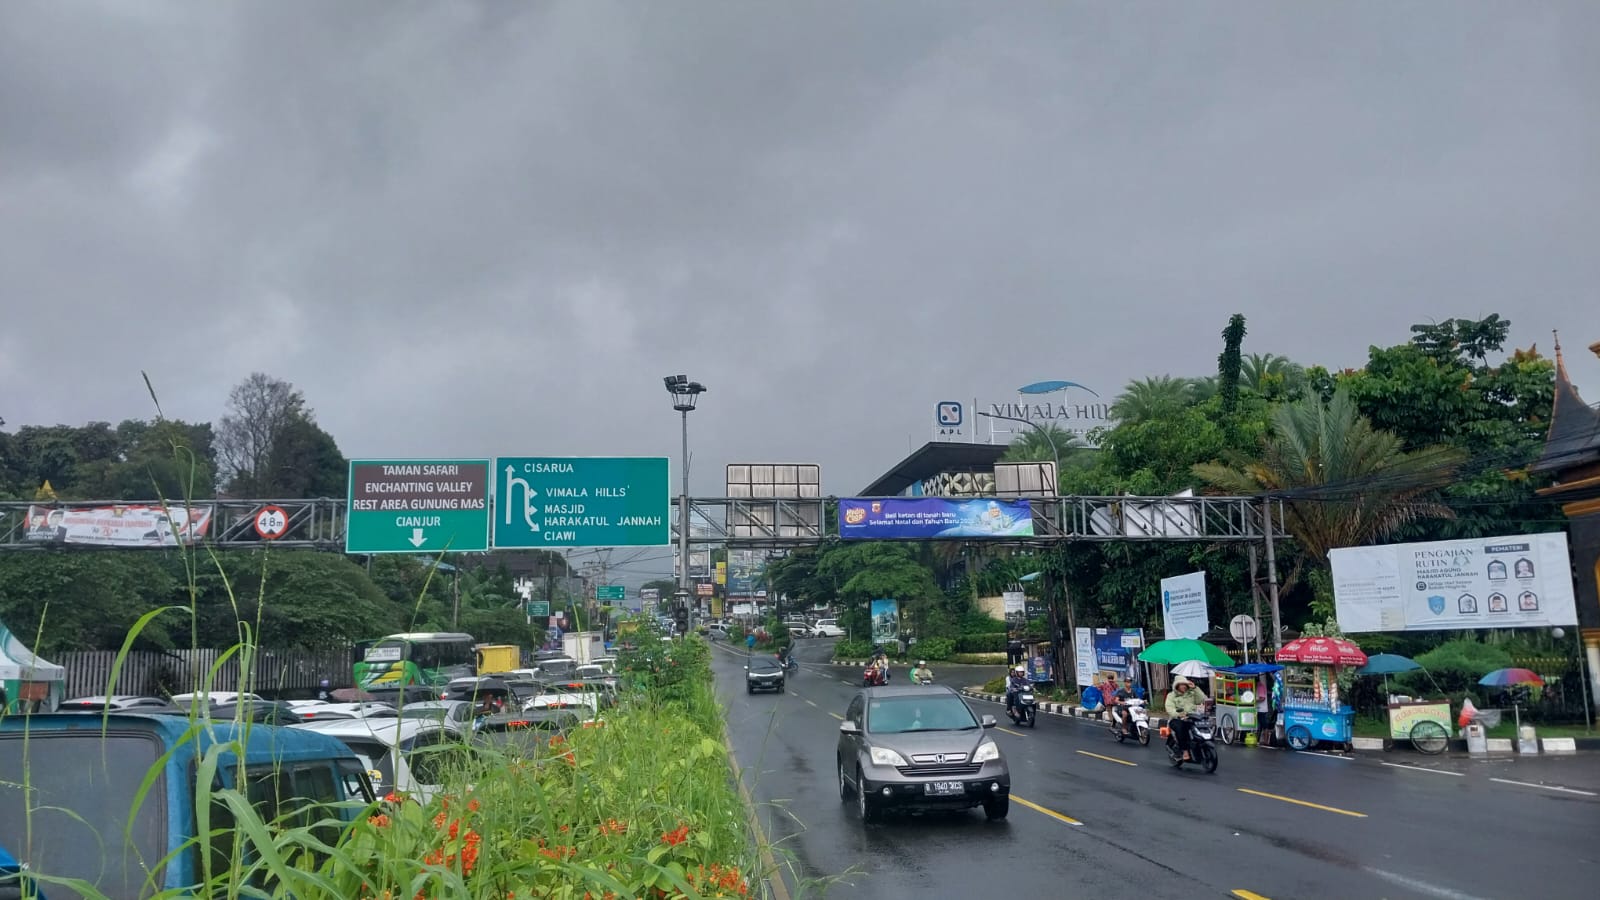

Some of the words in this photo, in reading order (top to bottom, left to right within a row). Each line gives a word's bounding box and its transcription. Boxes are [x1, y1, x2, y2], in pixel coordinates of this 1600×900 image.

[992, 402, 1070, 421] VIMALA
[383, 465, 420, 475] TAMAN
[424, 464, 459, 475] SAFARI
[524, 463, 574, 473] CISARUA
[365, 482, 433, 493] ENCHANTING
[436, 482, 473, 492] VALLEY
[546, 487, 588, 497] VIMALA
[595, 487, 626, 497] HILLS
[353, 499, 377, 510] REST
[380, 499, 408, 510] AREA
[411, 499, 458, 510] GUNUNG
[460, 498, 485, 509] MAS
[544, 504, 585, 514] MASJID
[259, 516, 284, 527] 48m
[395, 516, 441, 527] CIANJUR
[544, 516, 609, 526] HARAKATUL
[616, 516, 662, 526] JANNAH
[544, 531, 576, 541] CIAWI
[1414, 548, 1474, 559] PENGAJIAN
[1415, 559, 1448, 568] RUTIN
